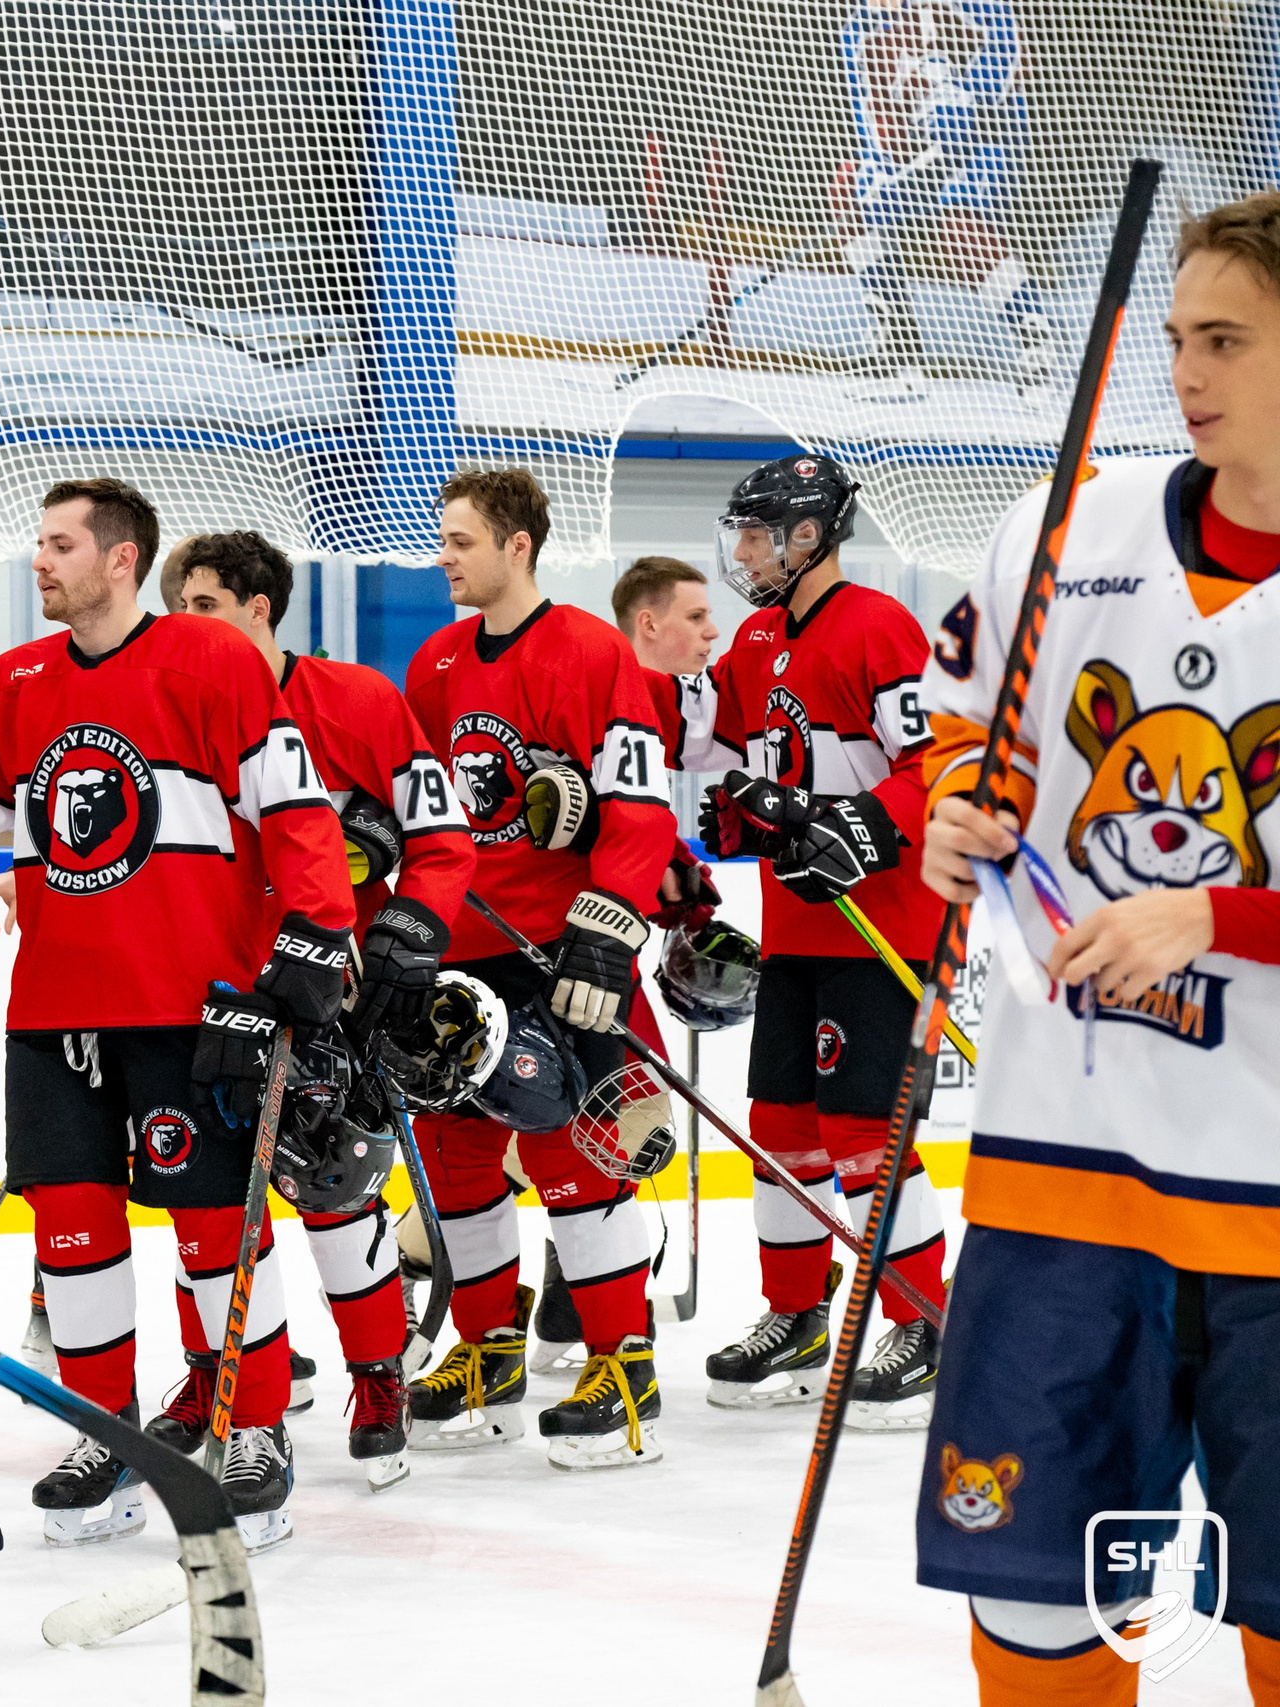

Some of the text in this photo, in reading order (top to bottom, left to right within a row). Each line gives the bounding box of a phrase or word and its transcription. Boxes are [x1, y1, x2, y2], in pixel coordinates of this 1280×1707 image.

[83, 728, 152, 793] EDITION
[476, 716, 533, 771] EDITION
[616, 736, 648, 788] 21
[471, 813, 527, 843] OSCOW
[46, 857, 130, 890] MOSCOW
[273, 933, 349, 969] BAUE
[140, 1107, 199, 1135] HOCKEY EDITION
[150, 1160, 188, 1175] MOSCOW
[276, 1143, 309, 1167] BAUER
[211, 1263, 254, 1444] SOYUZ
